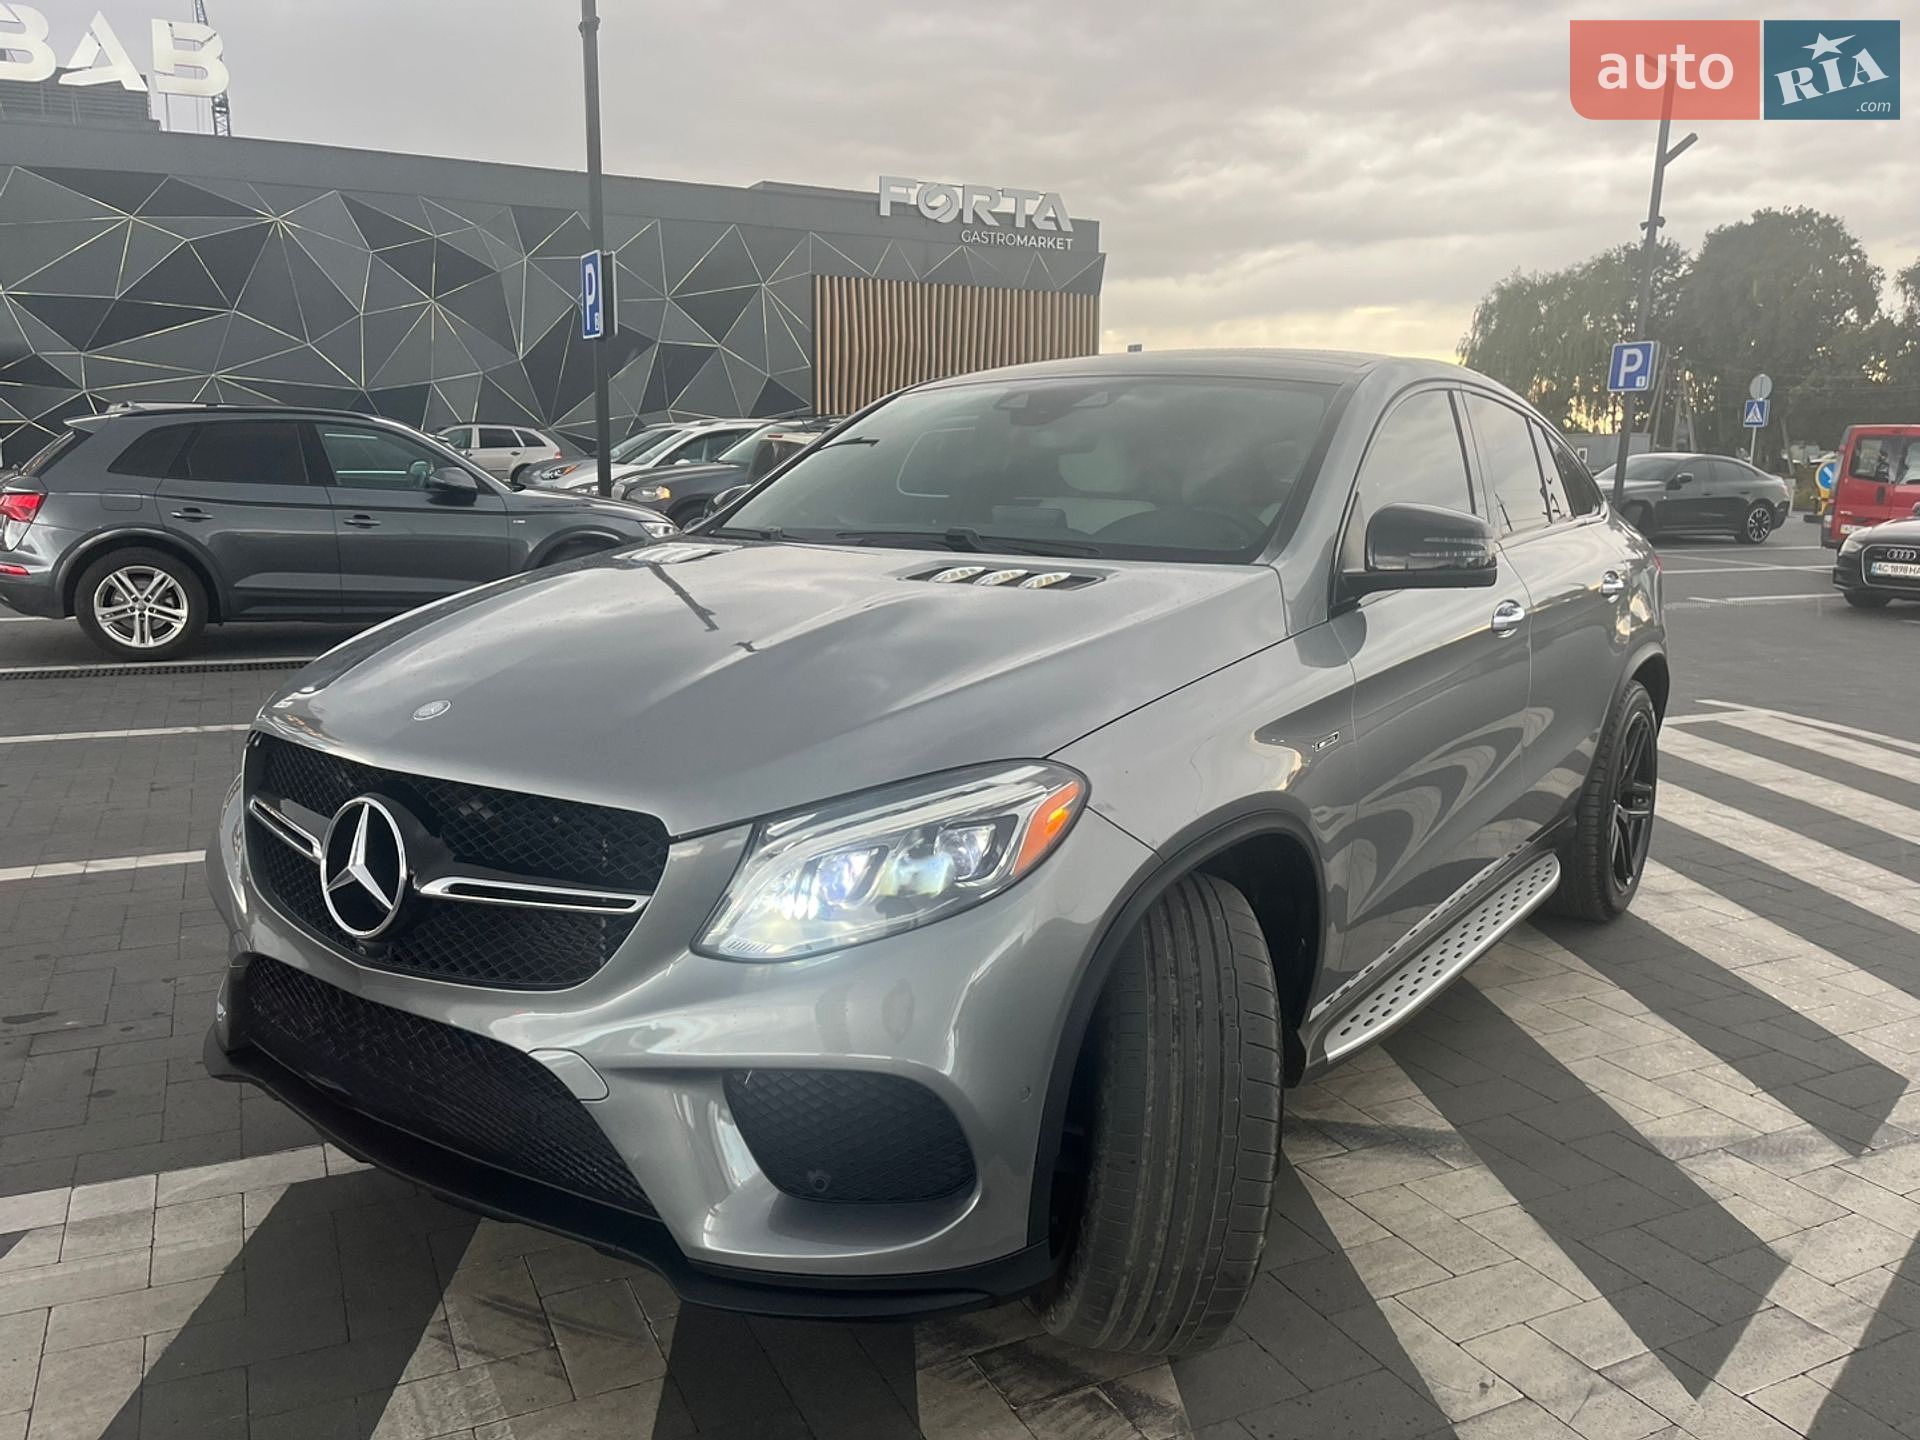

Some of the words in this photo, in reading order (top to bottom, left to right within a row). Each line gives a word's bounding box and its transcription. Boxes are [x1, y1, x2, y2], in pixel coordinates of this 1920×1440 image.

[878, 175, 1074, 232] FORTA
[961, 230, 1074, 251] GASTROMARKET
[585, 263, 596, 331] P
[1618, 348, 1643, 387] P
